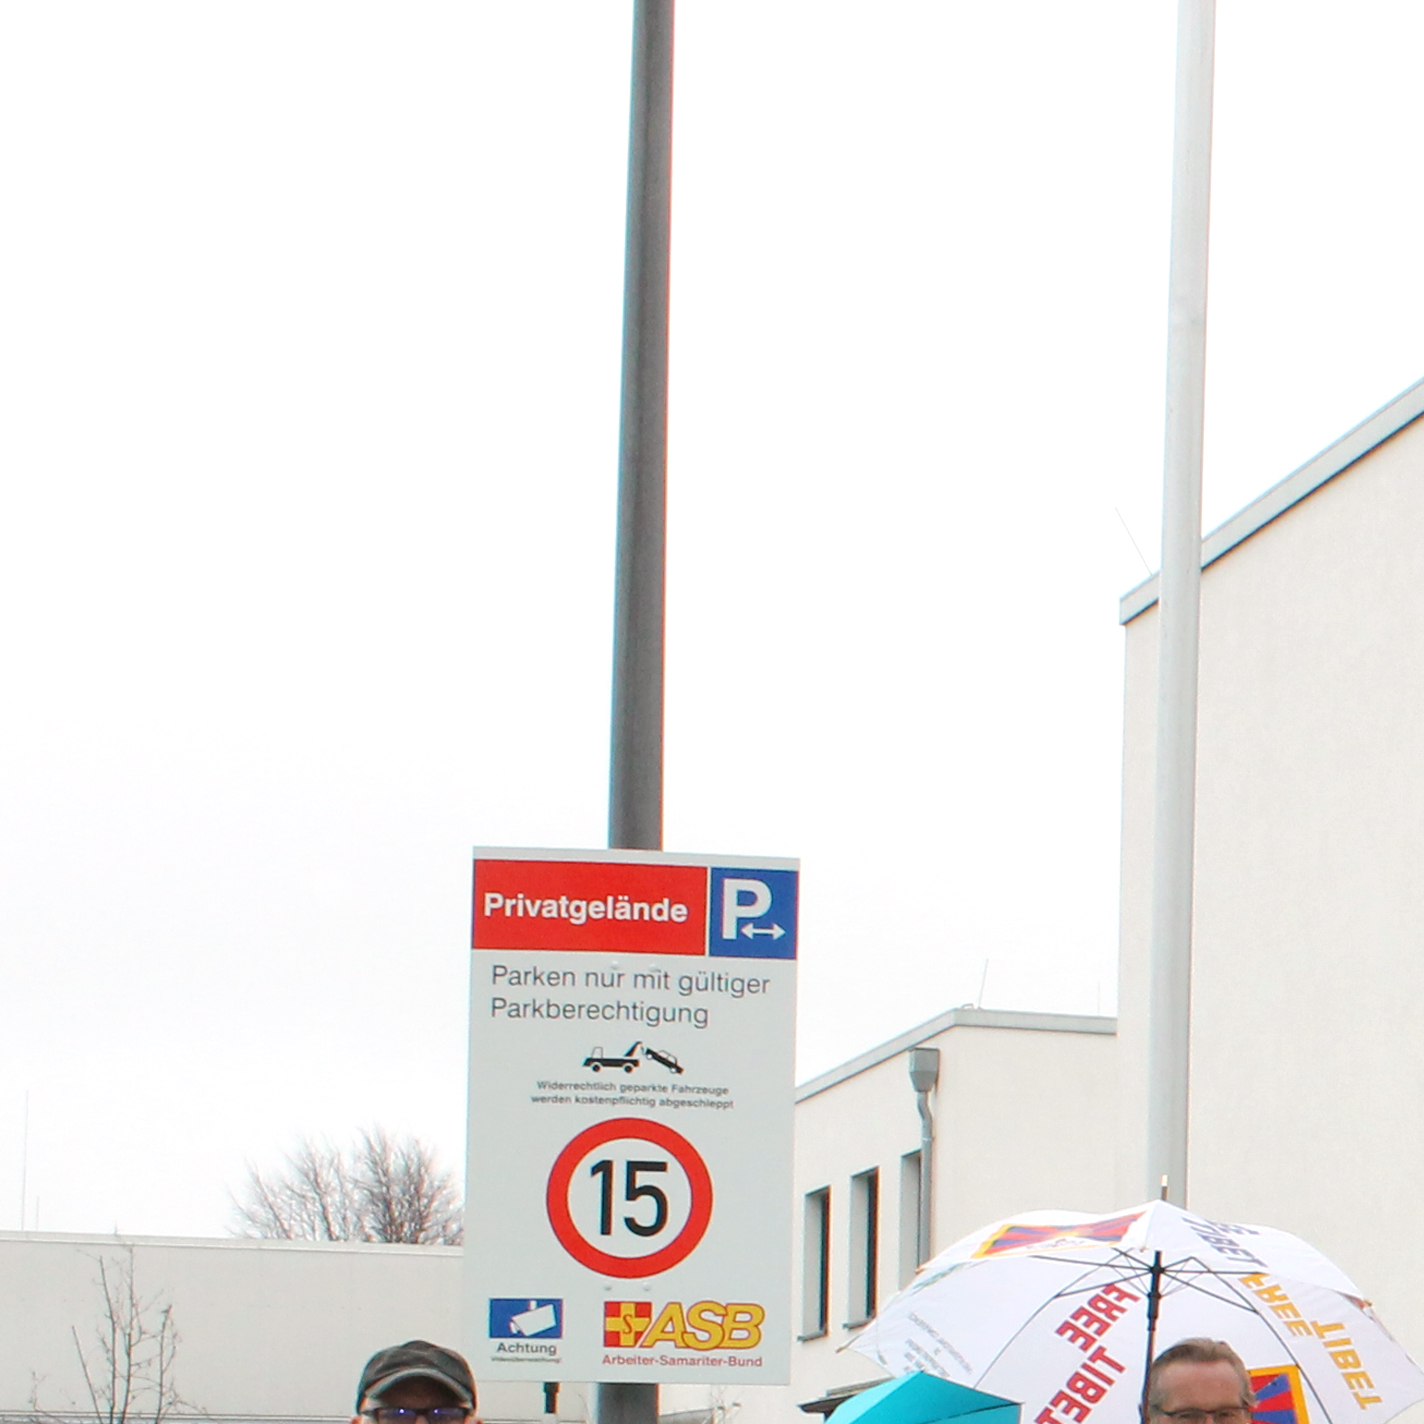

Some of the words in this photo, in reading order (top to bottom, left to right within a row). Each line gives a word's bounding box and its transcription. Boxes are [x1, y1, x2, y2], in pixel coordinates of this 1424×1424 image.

[483, 891, 690, 925] Privatgelände
[722, 878, 774, 940] P
[492, 964, 577, 987] Parken
[585, 969, 625, 989] nur
[633, 969, 671, 991] mit
[678, 972, 771, 999] gültiger
[491, 997, 710, 1029] Parkberechtigung
[531, 1095, 573, 1104] werden
[574, 1096, 656, 1107] kostenpflichtig
[659, 1098, 734, 1109] abgeschleppt
[537, 1081, 617, 1091] Widerrechtlich
[620, 1083, 668, 1093] geparkte
[671, 1084, 729, 1095] Fahrzeuge
[589, 1159, 669, 1238] 15
[639, 1300, 766, 1351] ASB
[496, 1341, 557, 1355] Achtung
[602, 1354, 763, 1367] Arbeiter-Samariter-Bund
